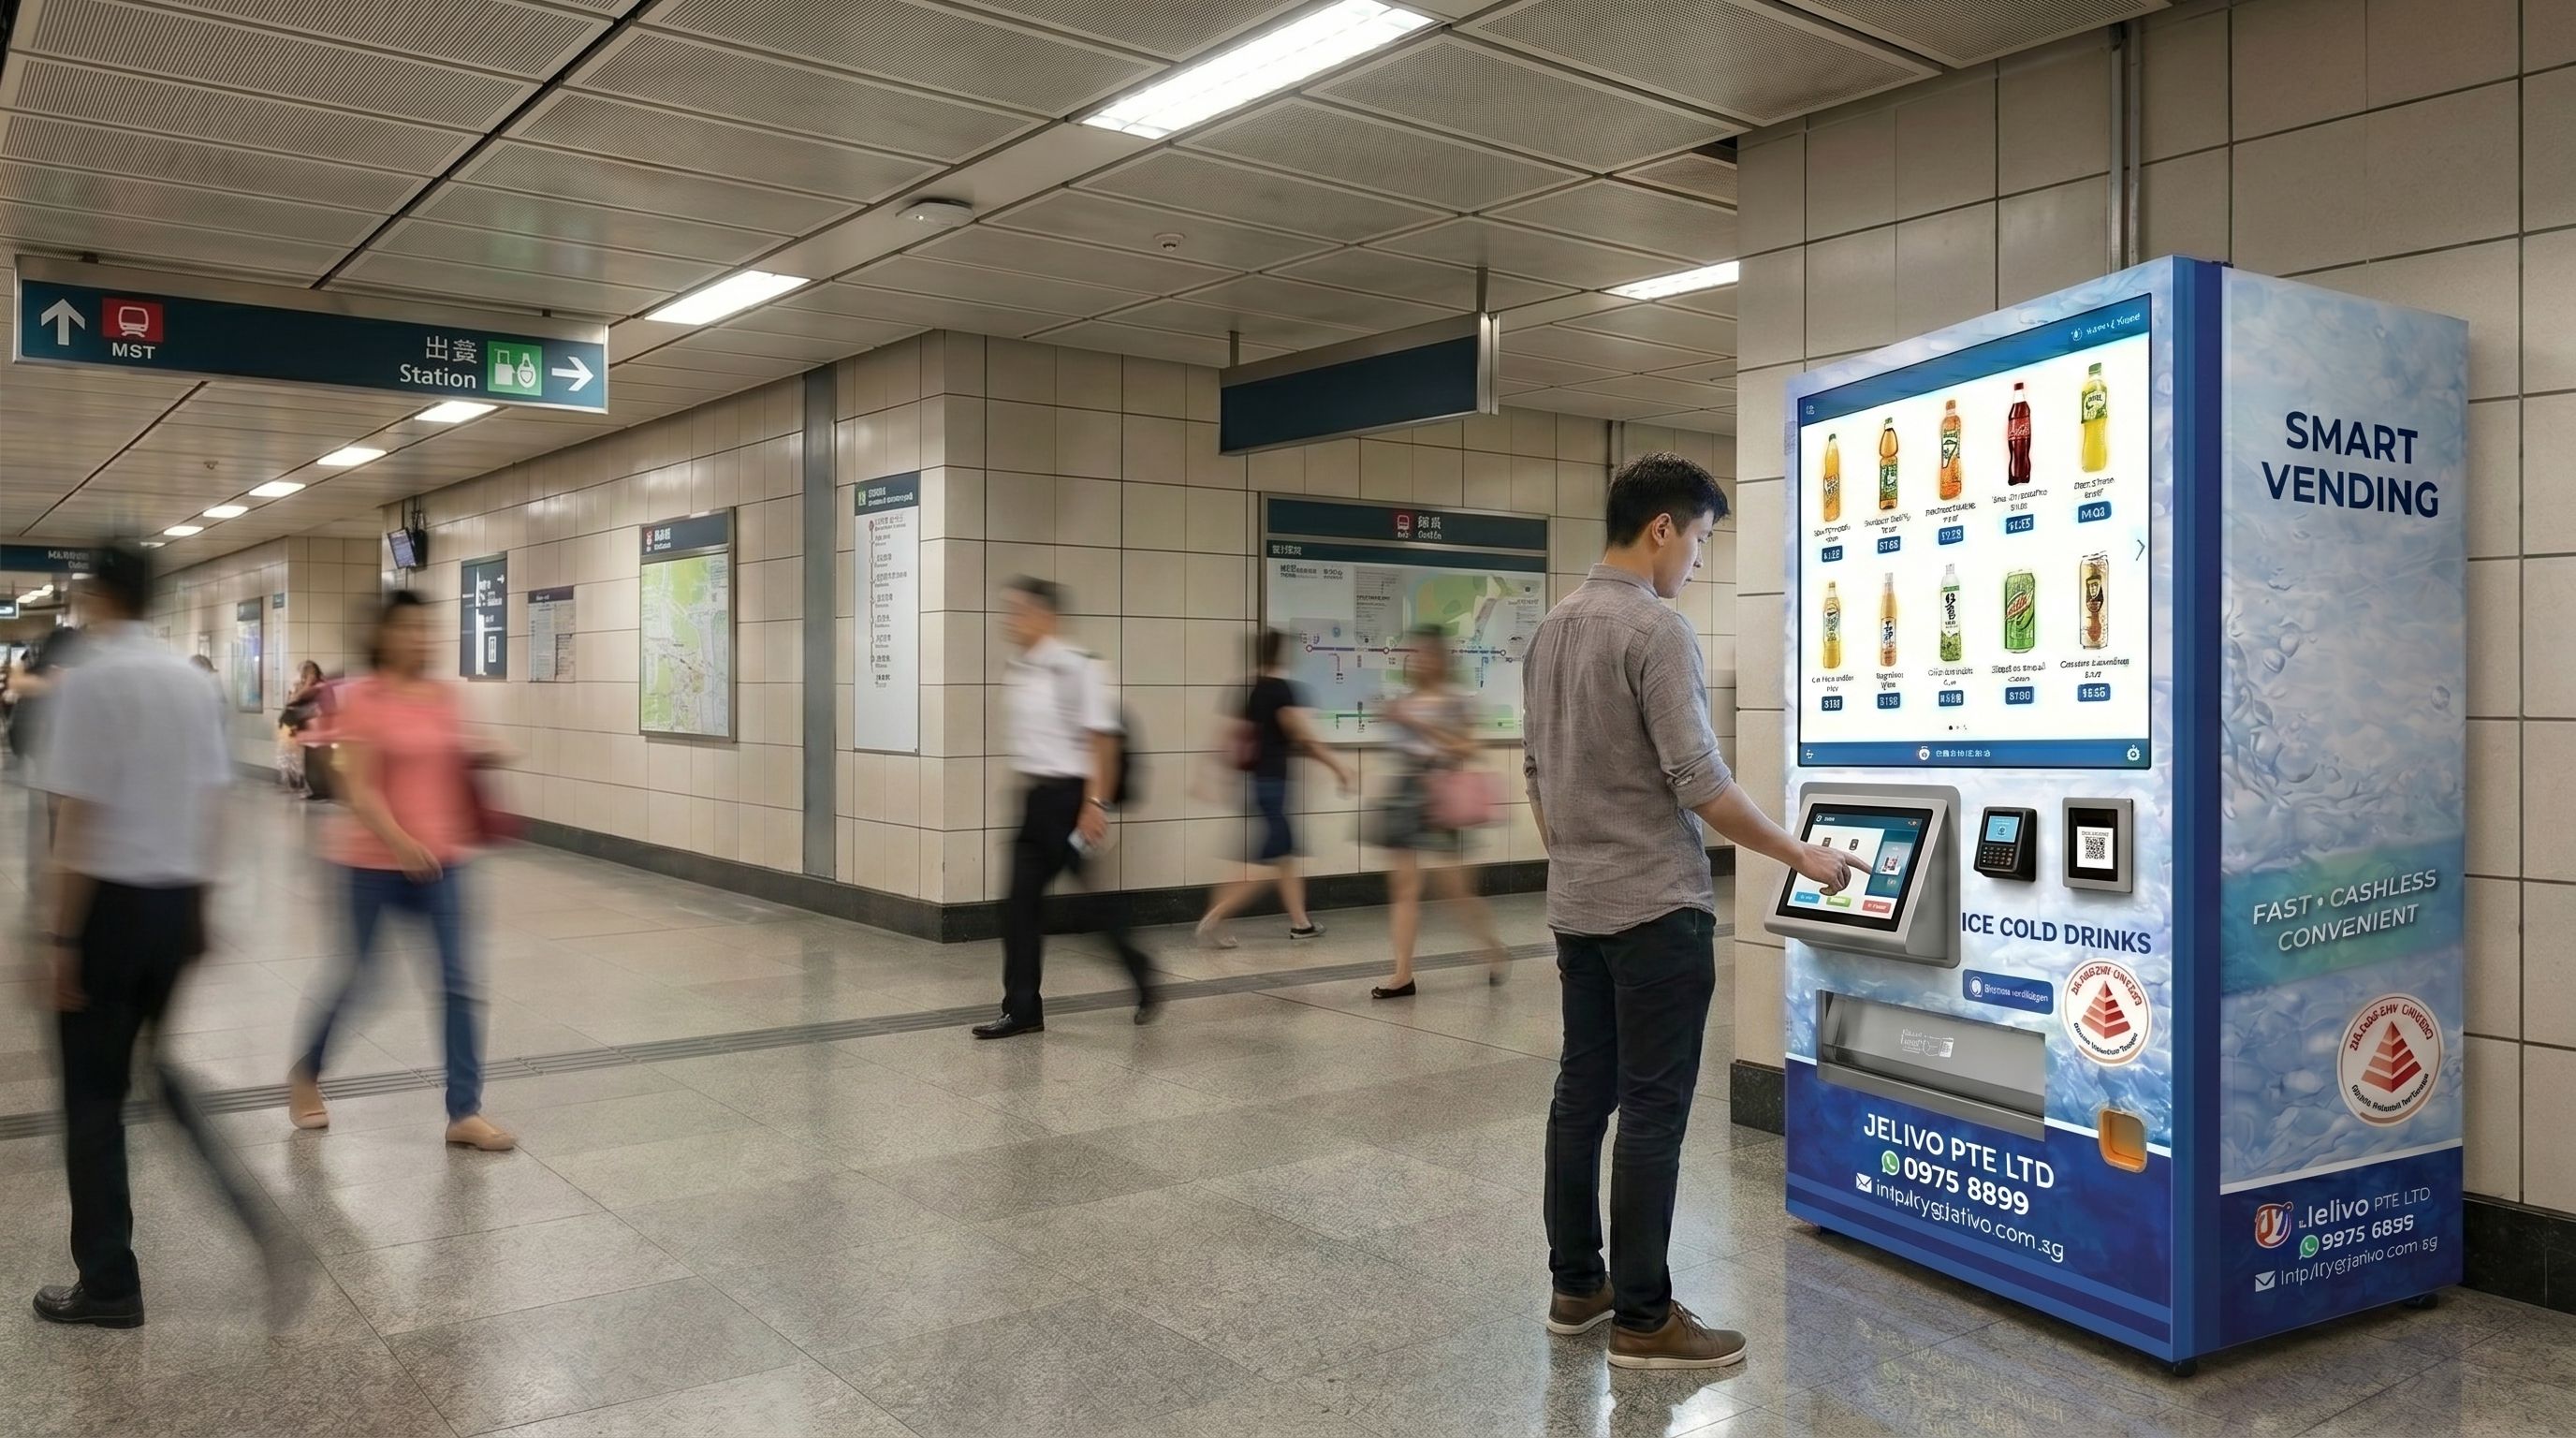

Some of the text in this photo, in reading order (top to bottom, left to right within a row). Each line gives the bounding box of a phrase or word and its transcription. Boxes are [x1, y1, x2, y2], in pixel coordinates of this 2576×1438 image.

[111, 342, 155, 360] MST
[400, 363, 476, 389] Station
[2286, 411, 2418, 464] SMART
[2261, 461, 2438, 518] VENDING
[2253, 869, 2437, 925] FAST CASHLESS
[1962, 913, 2152, 955] ICE COLD DRINKS
[2277, 903, 2420, 951] CONVENIENT
[1864, 1113, 2055, 1190] JELIVO PTE LTD
[1904, 1155, 2029, 1215] 0975 8899
[2375, 1193, 2399, 1211] PTE
[2405, 1187, 2431, 1206] LTD
